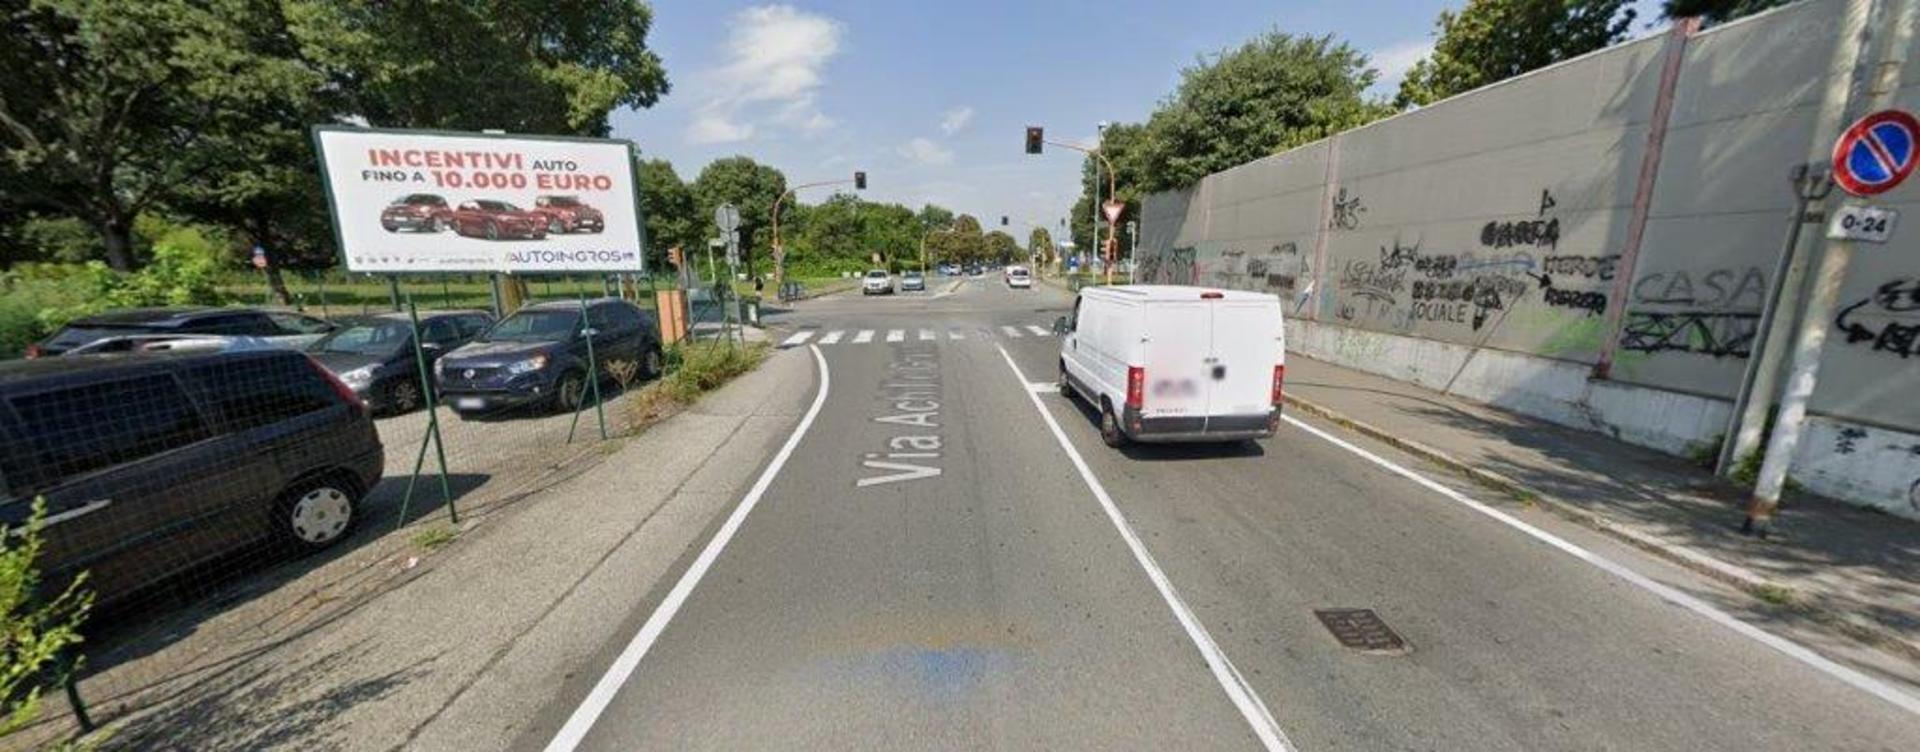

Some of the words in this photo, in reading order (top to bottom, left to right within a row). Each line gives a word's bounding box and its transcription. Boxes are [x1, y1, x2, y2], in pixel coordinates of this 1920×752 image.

[369, 149, 524, 170] INCENTIVI
[532, 159, 578, 172] AUTO
[361, 170, 407, 183] FINO
[412, 172, 425, 183] A
[431, 170, 527, 190] 10.000
[536, 174, 613, 192] EURO
[1842, 213, 1887, 233] 0-24
[510, 250, 622, 264] AUTOINGROS
[1633, 267, 1766, 306] CASA
